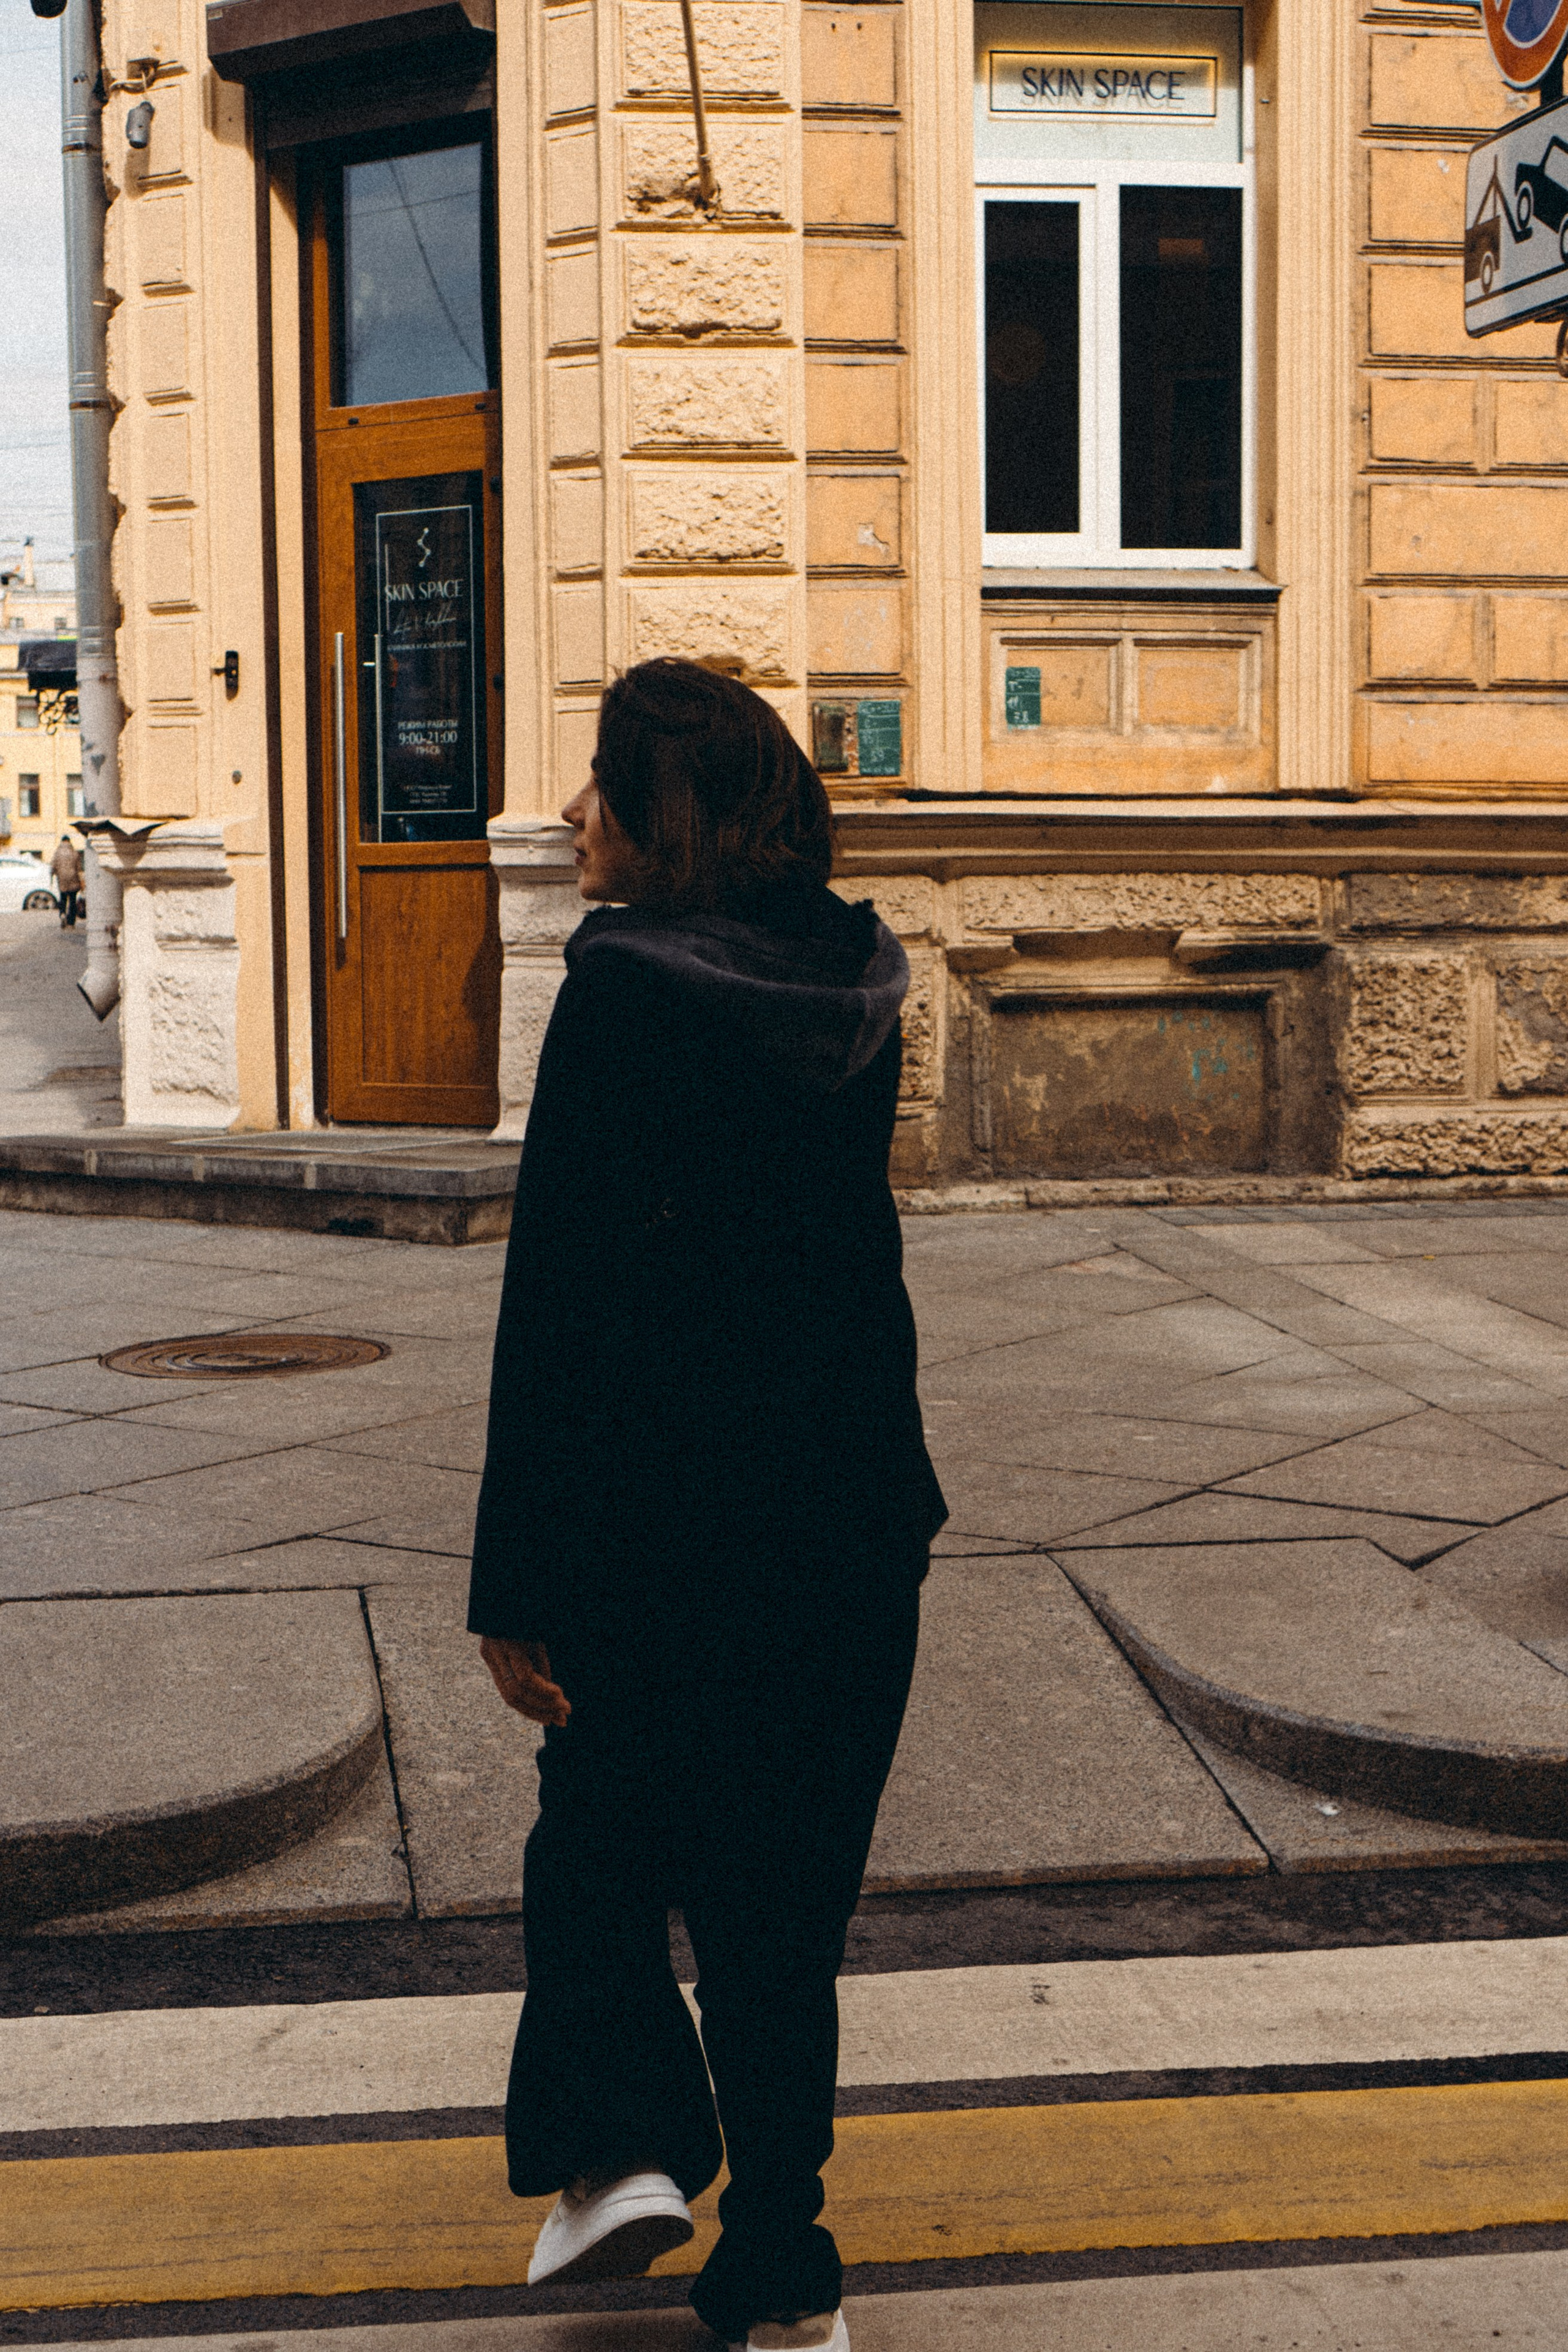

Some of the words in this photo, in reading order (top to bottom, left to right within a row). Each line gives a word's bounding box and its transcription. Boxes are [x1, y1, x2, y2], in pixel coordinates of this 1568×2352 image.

[1022, 67, 1084, 97] SKIN
[1095, 69, 1186, 100] SPACE
[385, 584, 415, 601] SKIN
[419, 579, 464, 598] SPACE
[399, 730, 458, 745] 9:00-21:00
